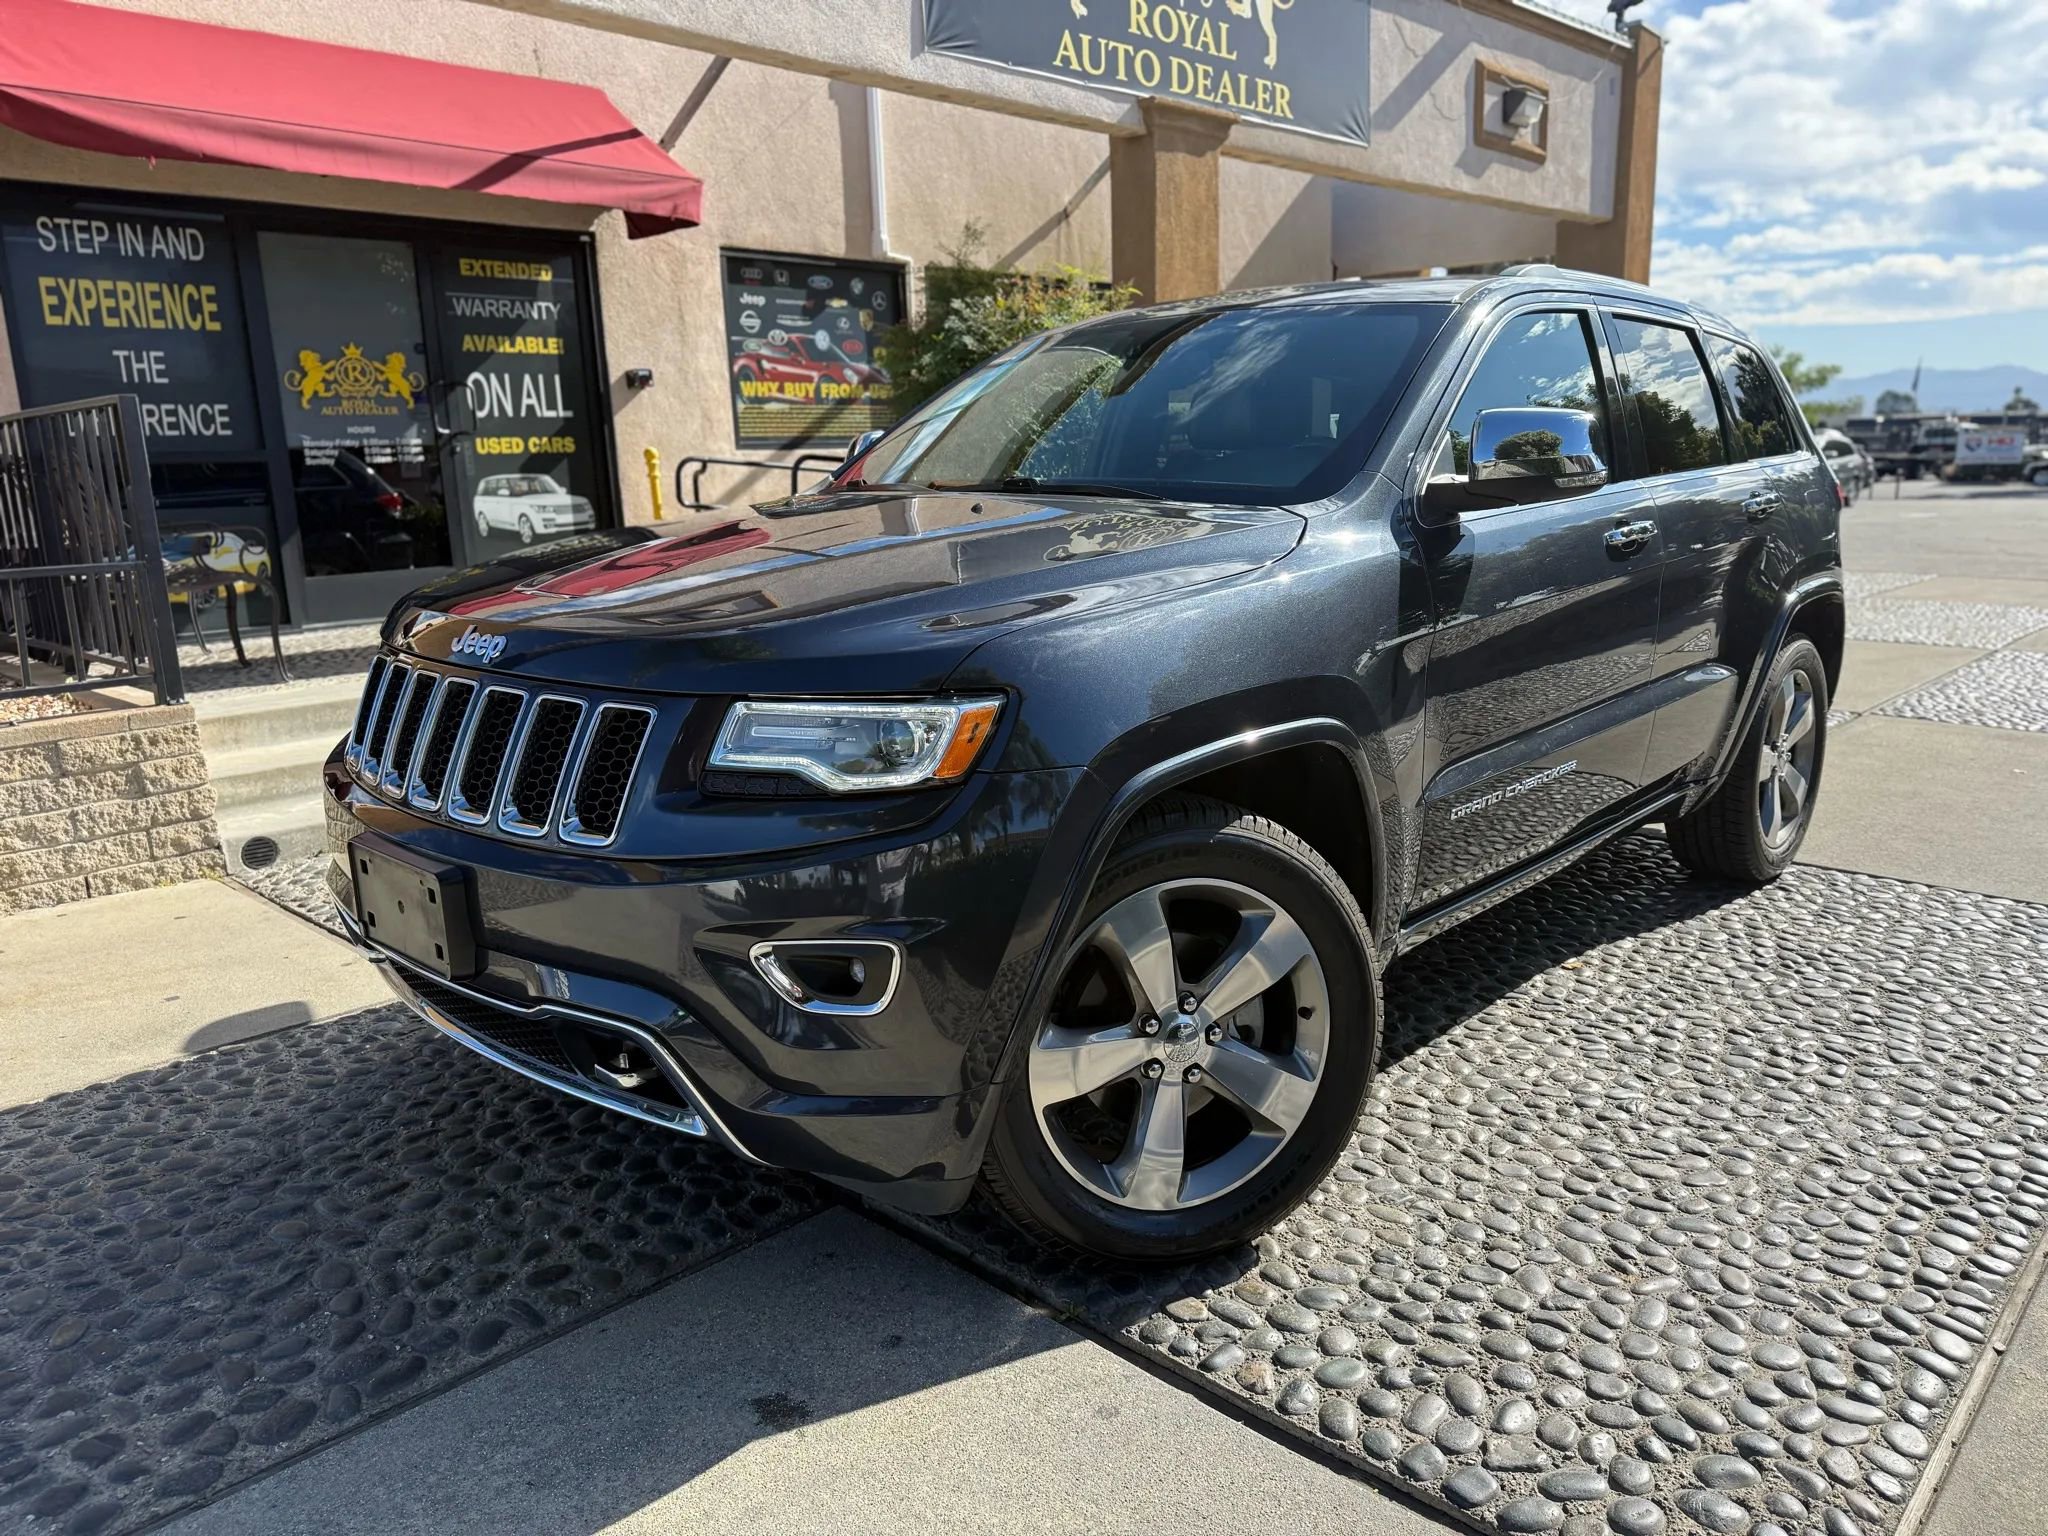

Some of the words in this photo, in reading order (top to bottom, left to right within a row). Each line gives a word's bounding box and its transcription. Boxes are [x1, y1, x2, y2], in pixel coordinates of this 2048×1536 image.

[1128, 0, 1237, 61] ROYAL
[1052, 29, 1161, 88] AUTO
[1168, 55, 1294, 119] DEALER
[36, 216, 109, 255] STEP
[116, 222, 145, 258] IN
[151, 225, 205, 262] AND
[459, 258, 552, 281] EXTENDED
[38, 276, 221, 331] EXPERIENCE
[452, 298, 561, 320] WARRANTY
[463, 334, 564, 355] AVAILABLE!
[112, 350, 169, 383] THE
[466, 371, 513, 418] ON
[520, 373, 573, 418] ALL
[740, 381, 779, 398] WHY
[784, 382, 817, 398] BUY
[821, 384, 864, 399] FROM
[475, 437, 524, 455] USED
[528, 437, 575, 454] CARS
[451, 624, 507, 663] Jeep
[1450, 790, 1502, 820] GRAND
